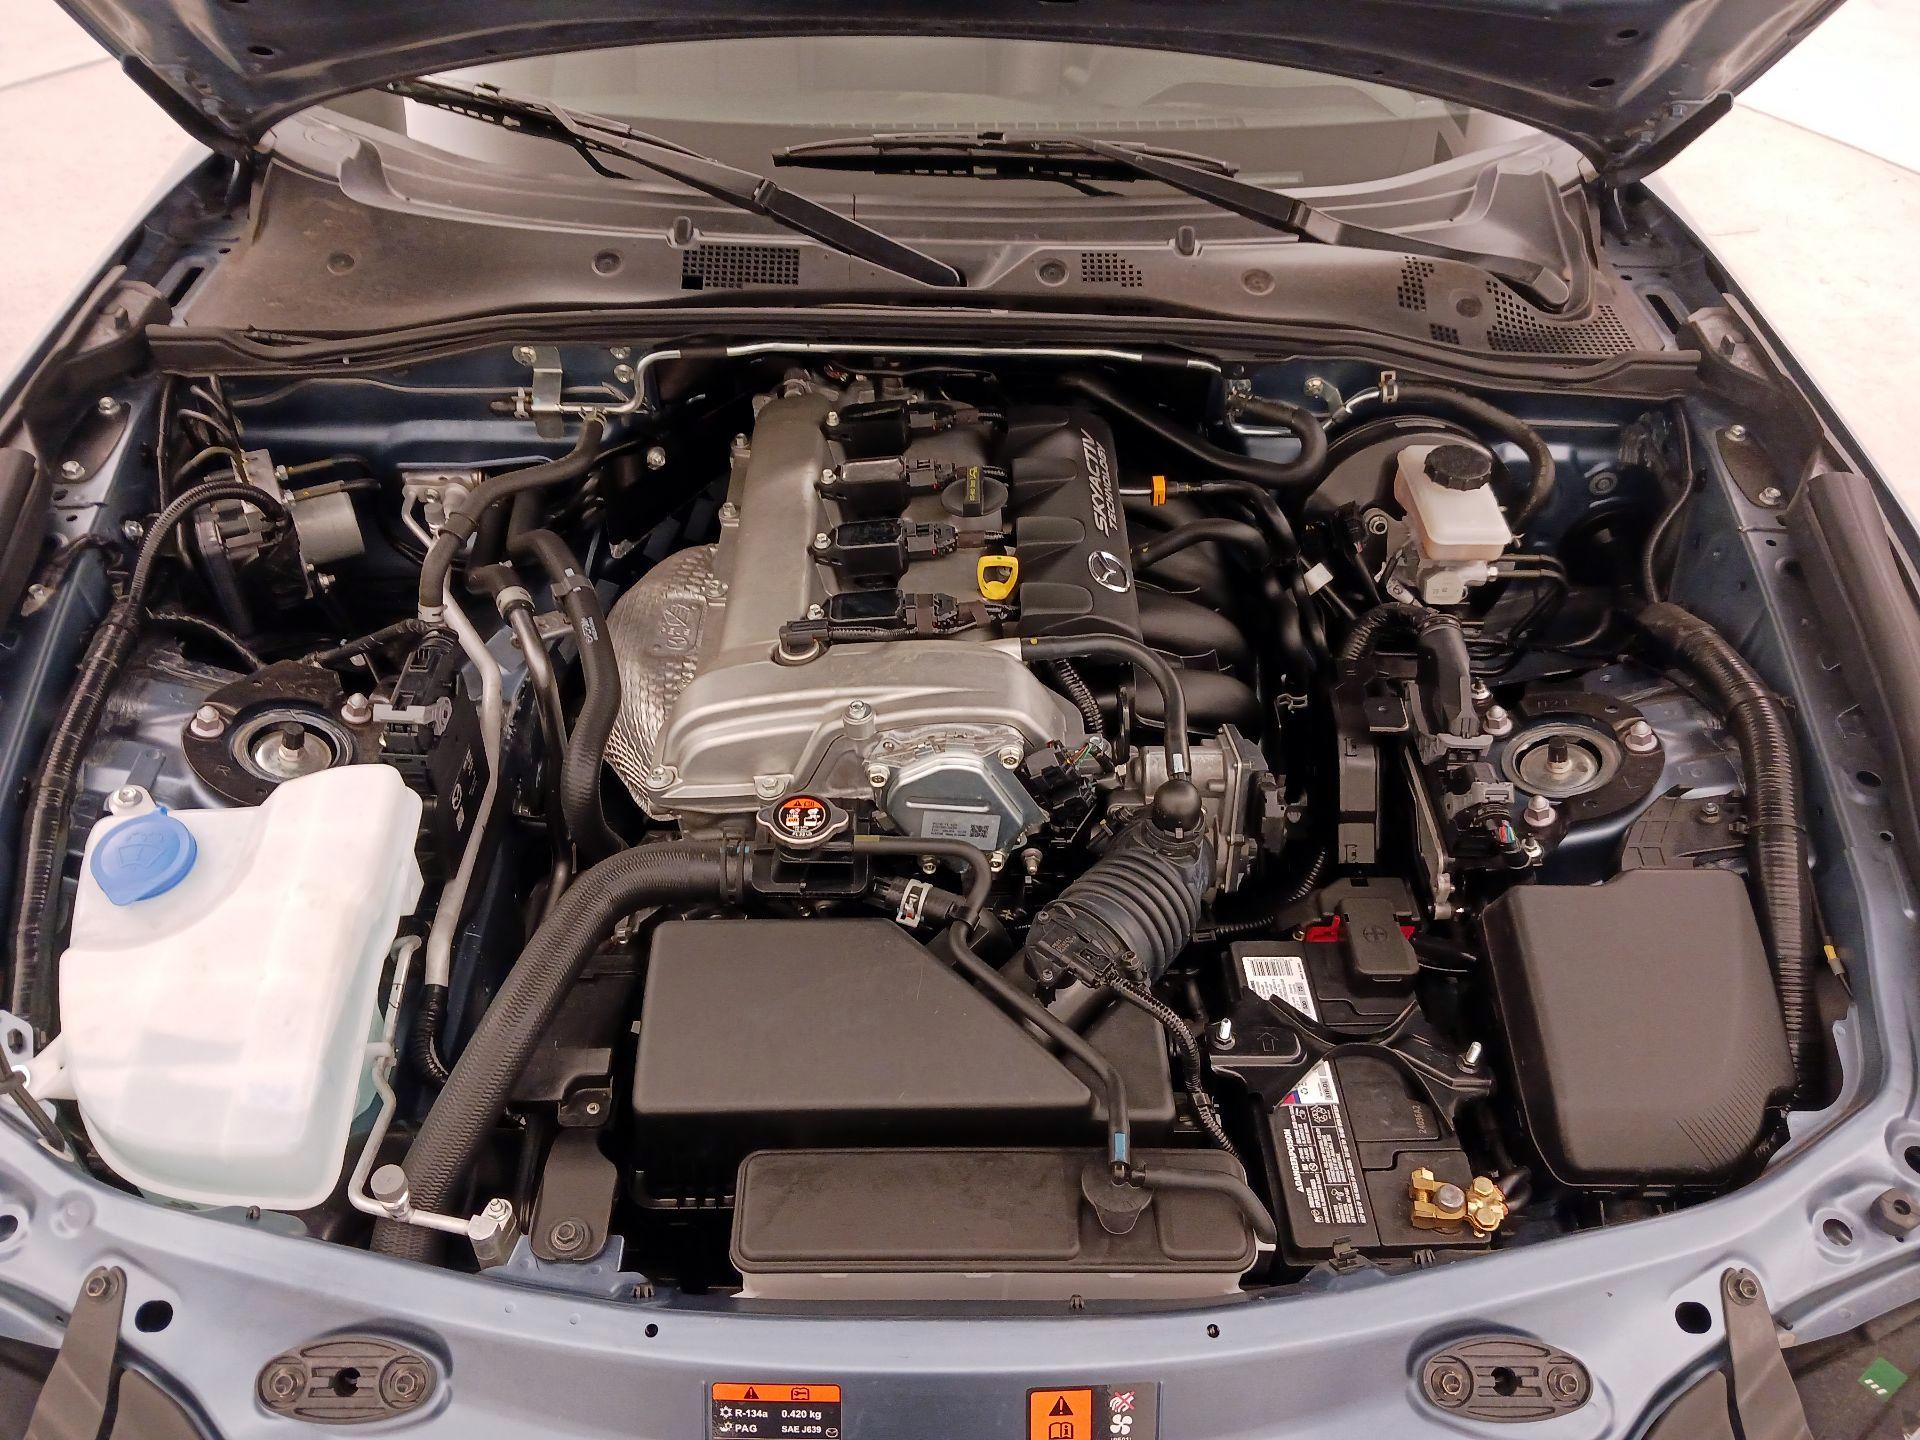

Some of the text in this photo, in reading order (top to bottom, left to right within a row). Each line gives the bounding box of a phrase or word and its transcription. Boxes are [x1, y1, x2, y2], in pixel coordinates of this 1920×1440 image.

[1081, 428, 1110, 538] SKYACTIV
[1096, 441, 1118, 531] TECHNOLOGY
[735, 1409, 822, 1420] R-134a 0.420 kg
[735, 1425, 822, 1433] PAG SAE J639
